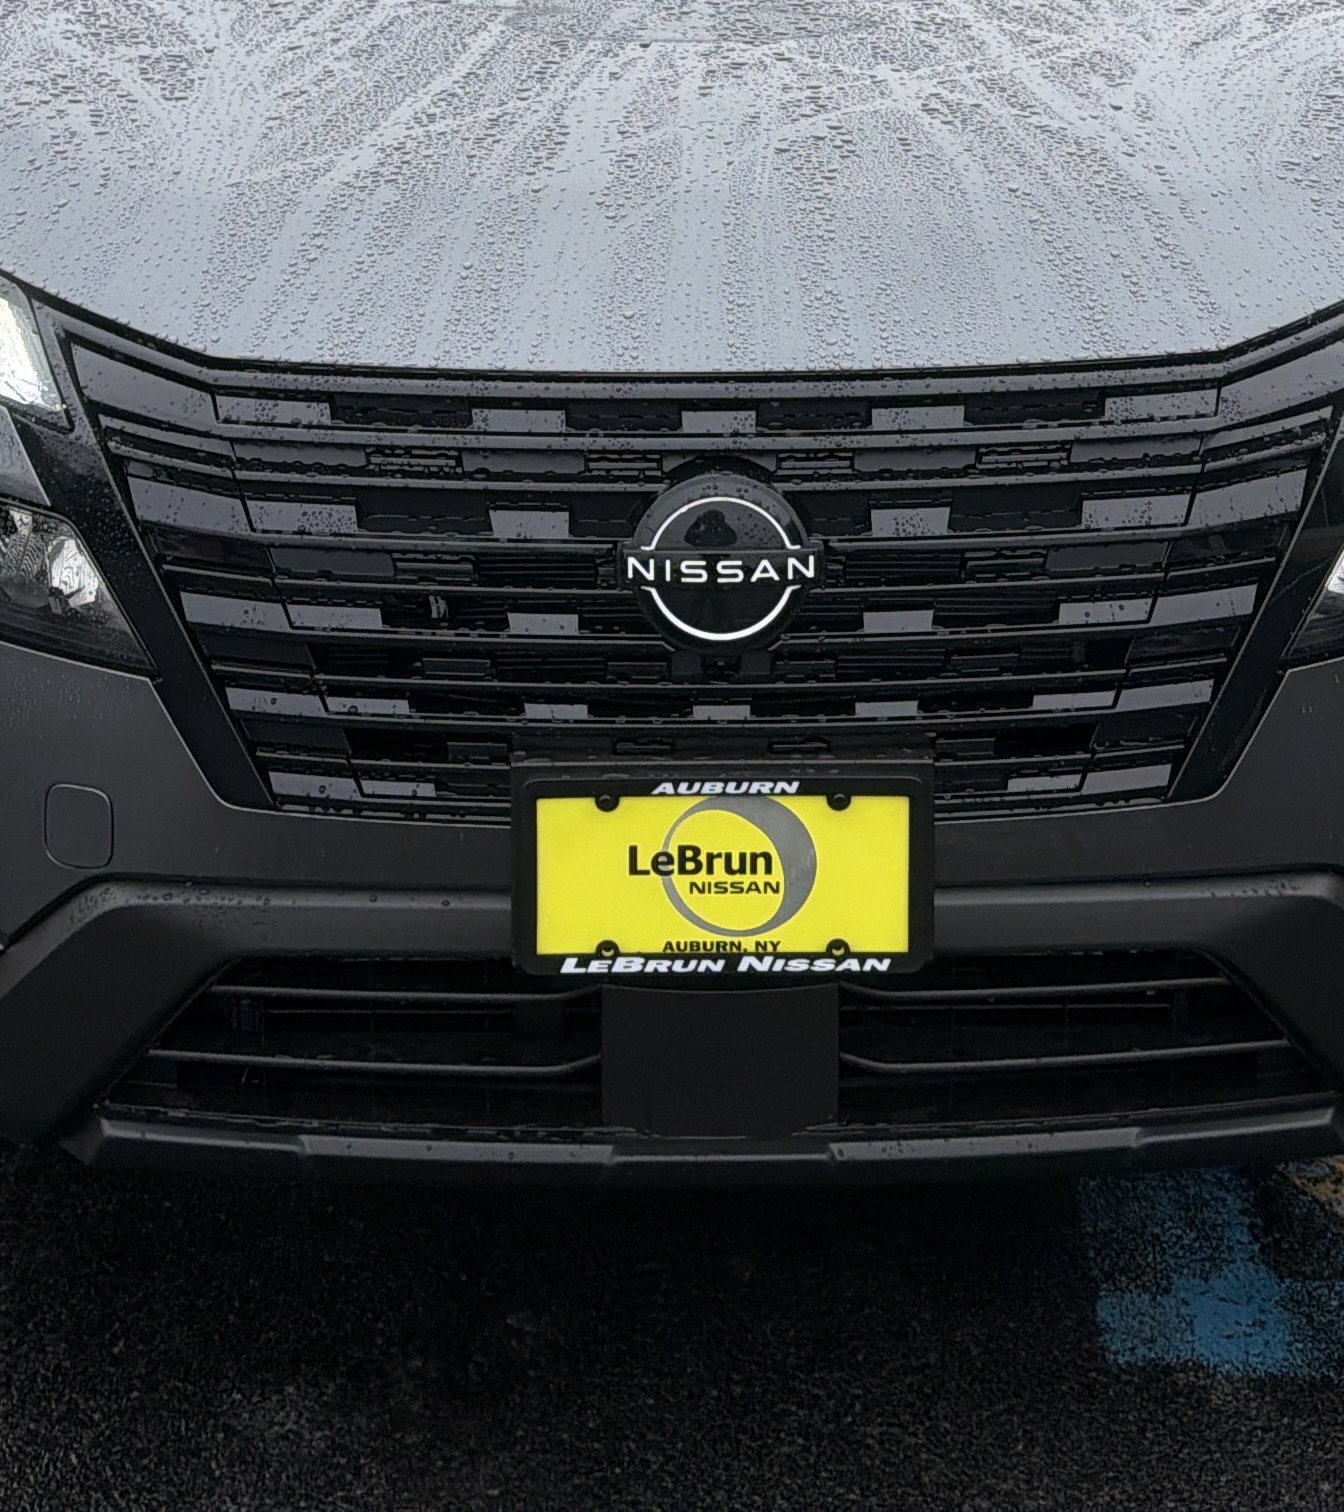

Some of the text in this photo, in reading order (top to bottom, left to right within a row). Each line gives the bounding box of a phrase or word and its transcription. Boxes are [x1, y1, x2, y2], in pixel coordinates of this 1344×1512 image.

[627, 555, 815, 584] NISSAN
[651, 781, 801, 795] AUBURN
[628, 844, 773, 877] LeBrun
[689, 881, 781, 896] NISSAN
[663, 941, 782, 953] AUBURN, NY
